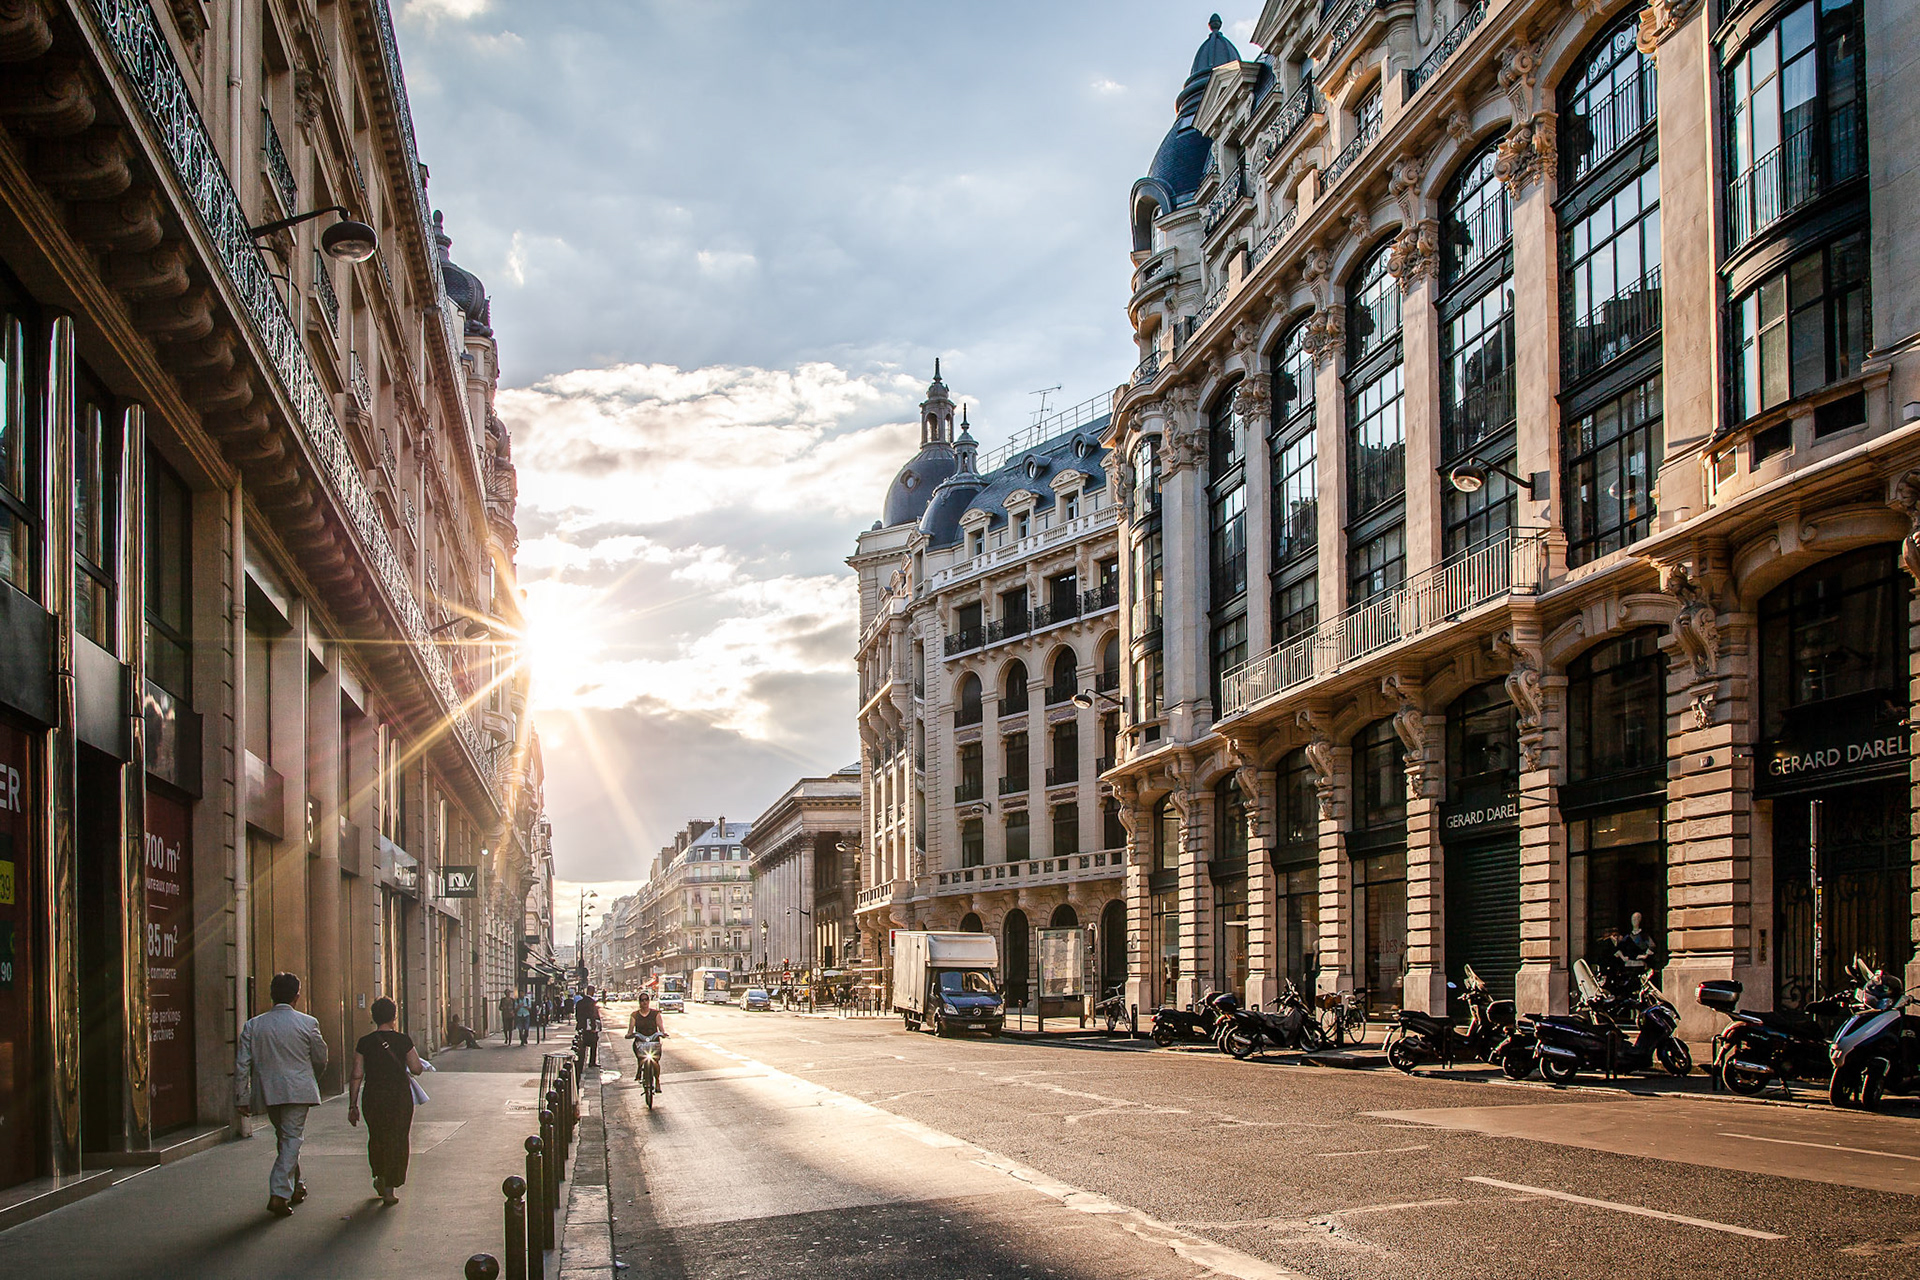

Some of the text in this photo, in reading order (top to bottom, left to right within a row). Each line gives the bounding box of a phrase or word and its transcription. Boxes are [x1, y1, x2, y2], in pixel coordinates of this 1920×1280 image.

[1769, 735, 1909, 776] GERARD DAREL
[0, 763, 21, 813] ER
[1446, 803, 1519, 829] GERARD DAREL
[148, 922, 161, 957] 85
